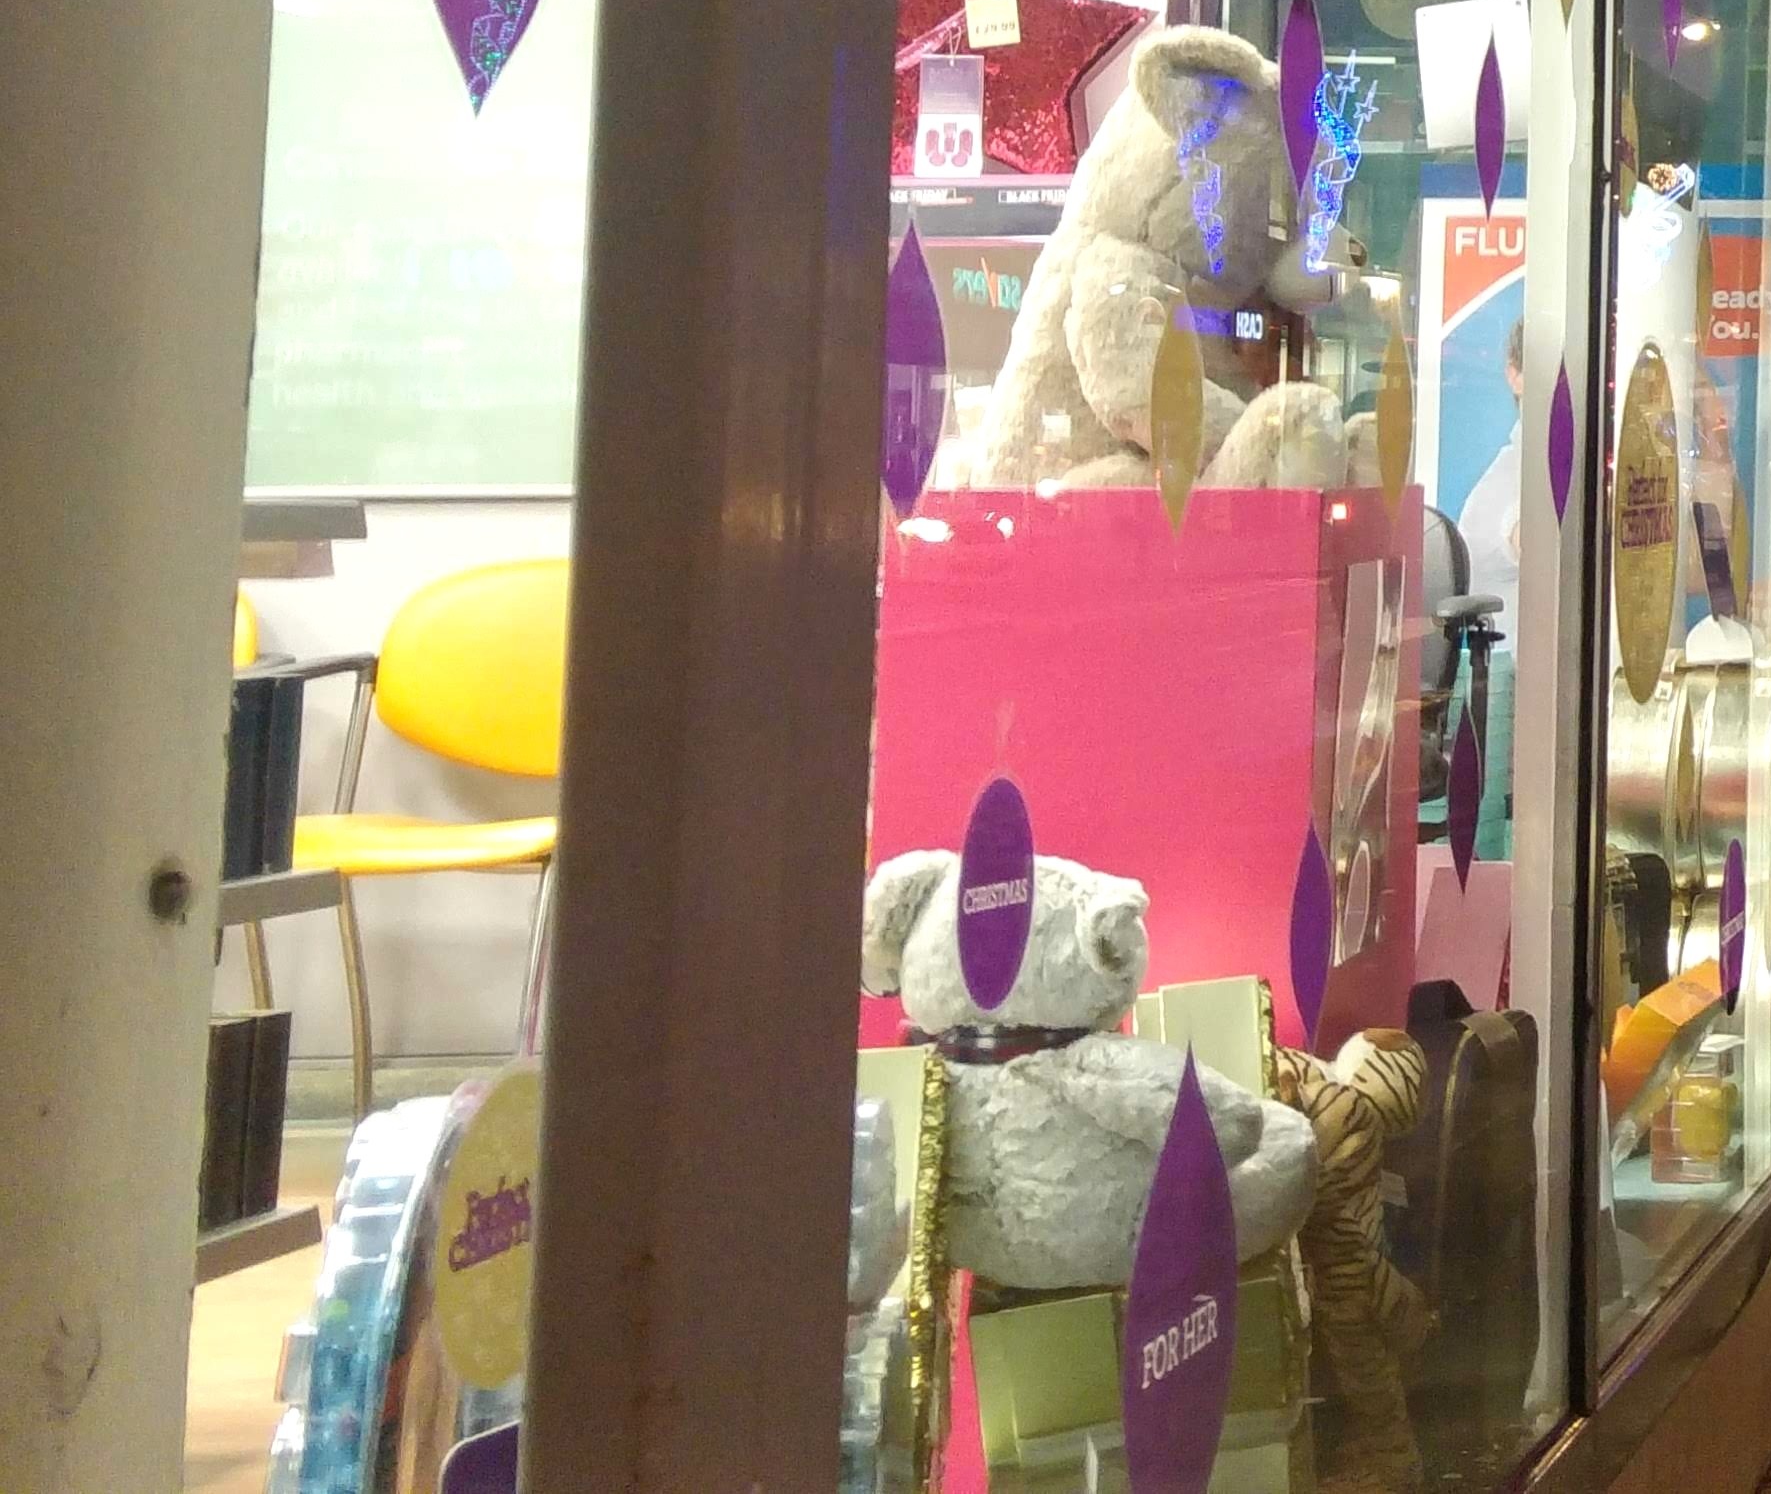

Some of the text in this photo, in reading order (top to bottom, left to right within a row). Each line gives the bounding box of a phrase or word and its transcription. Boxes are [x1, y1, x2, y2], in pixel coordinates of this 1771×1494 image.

[1454, 226, 1525, 257] FLU
[962, 878, 1028, 915] CHRISTMAS
[1141, 1299, 1218, 1389] FOR HER
